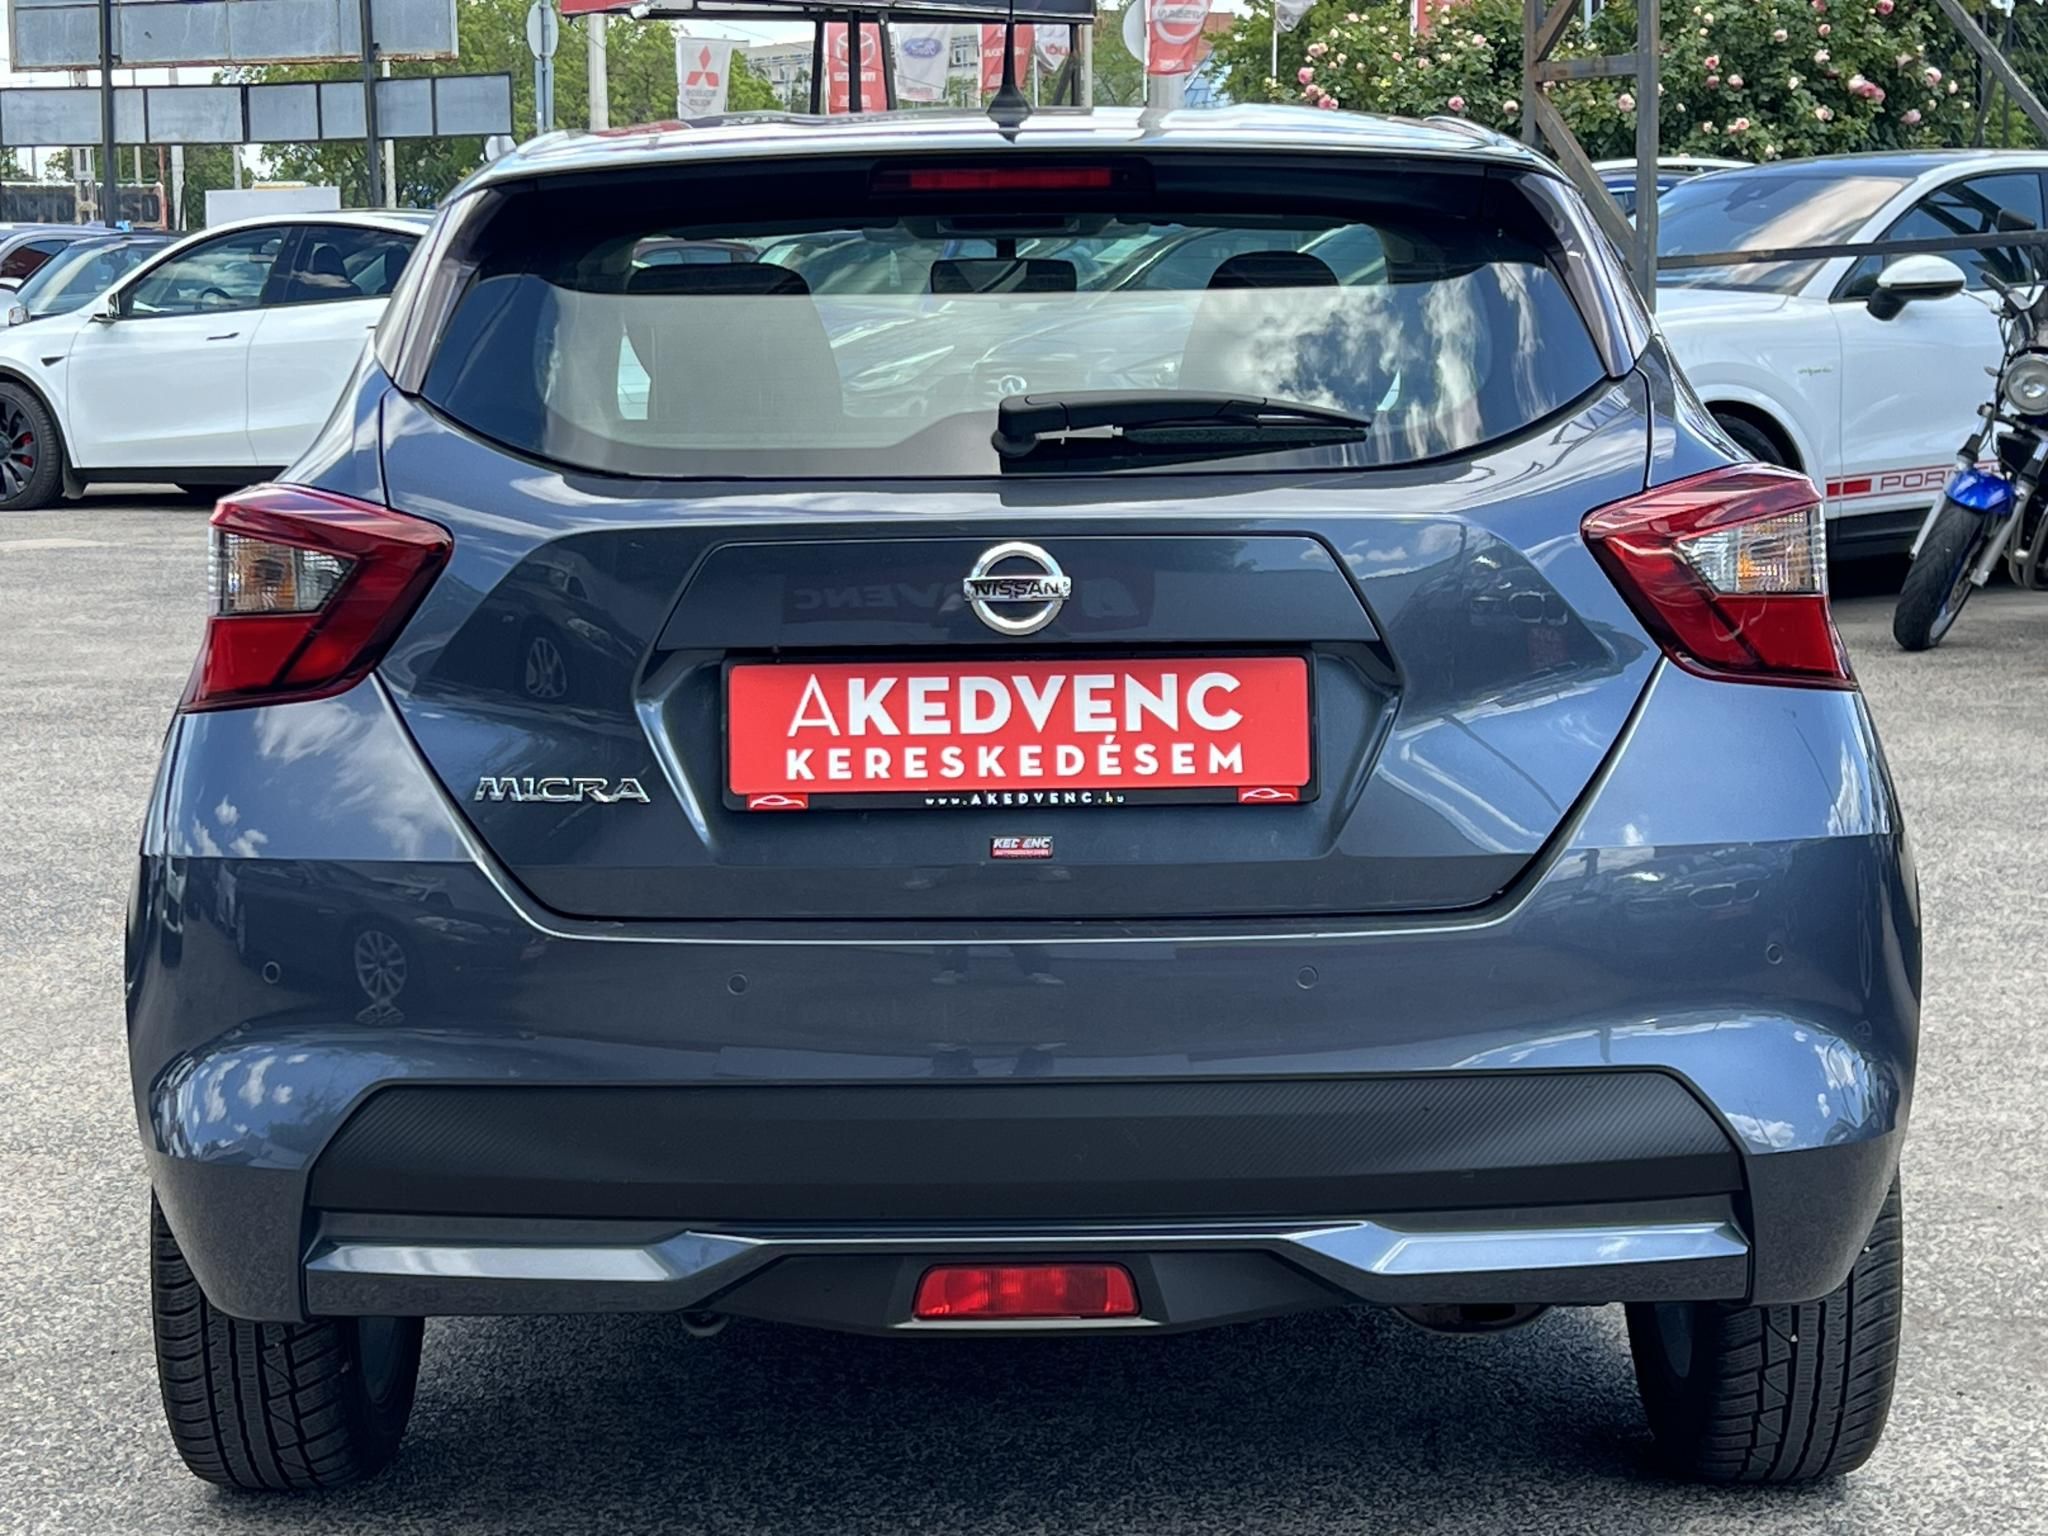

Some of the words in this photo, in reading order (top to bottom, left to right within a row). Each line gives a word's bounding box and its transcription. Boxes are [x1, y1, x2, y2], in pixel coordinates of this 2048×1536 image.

[973, 581, 1060, 597] NISSAN
[786, 735, 1244, 781] KERESKEDÉSEM
[474, 776, 651, 803] MICRA
[925, 791, 1125, 806] www.AKEDVENC.hu
